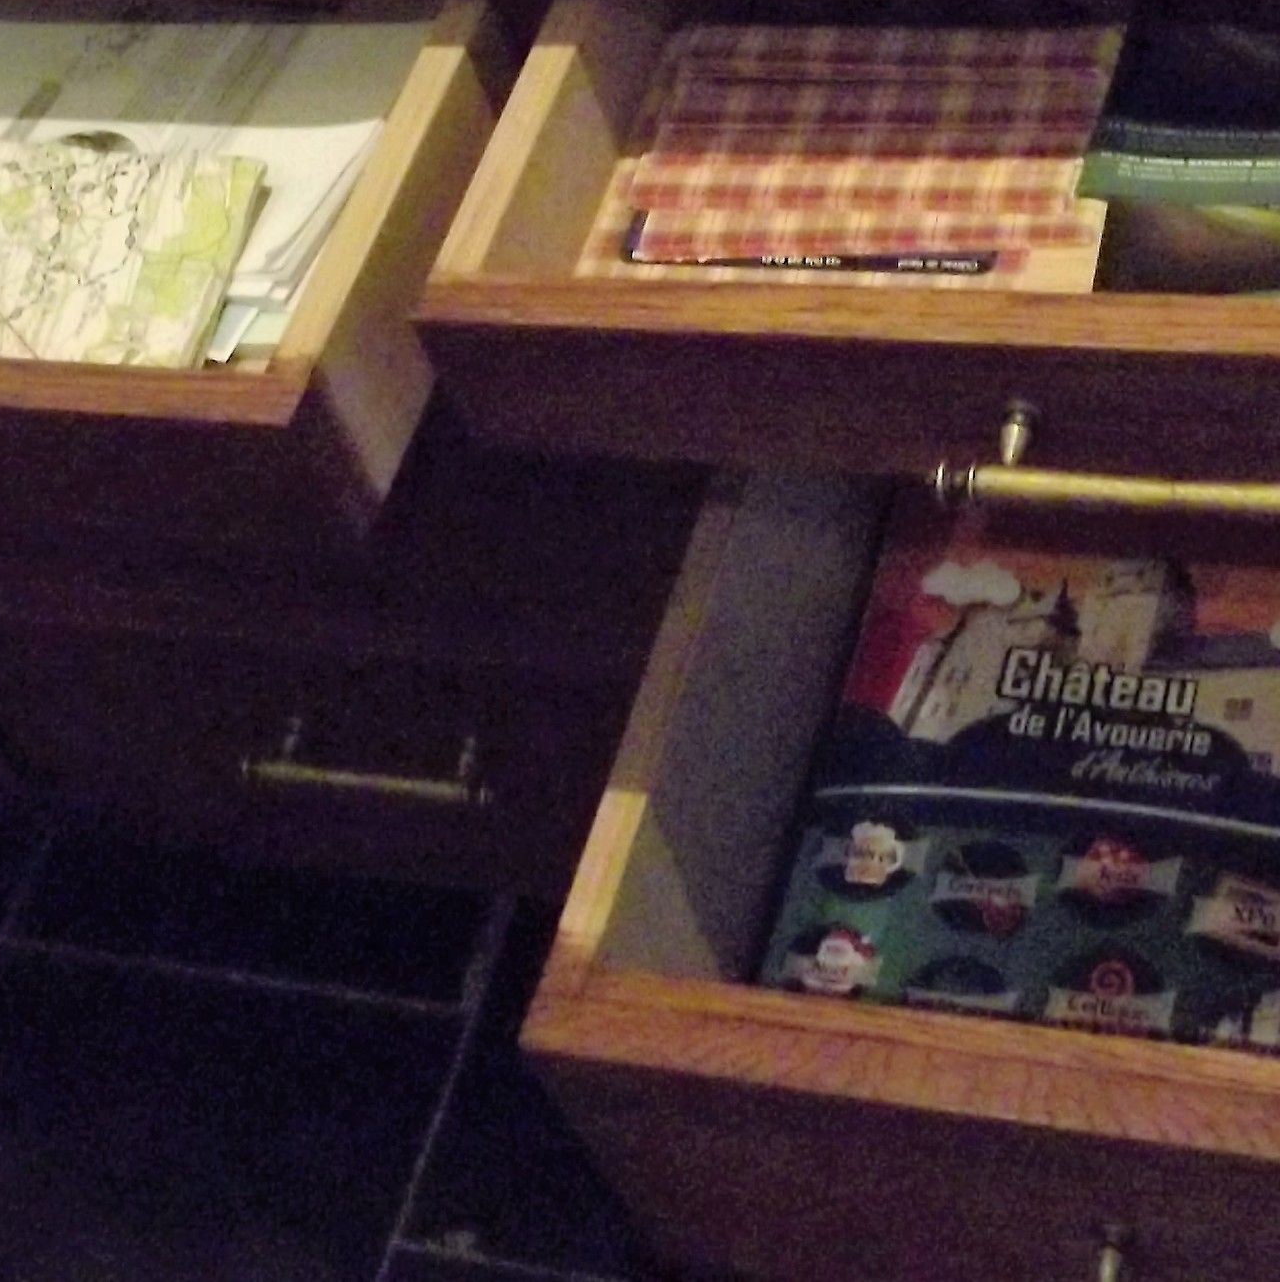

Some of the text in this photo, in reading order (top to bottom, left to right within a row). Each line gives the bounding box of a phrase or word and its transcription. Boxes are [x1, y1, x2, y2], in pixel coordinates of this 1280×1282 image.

[999, 648, 1197, 715] Château
[1008, 703, 1213, 756] de l'Avouerie
